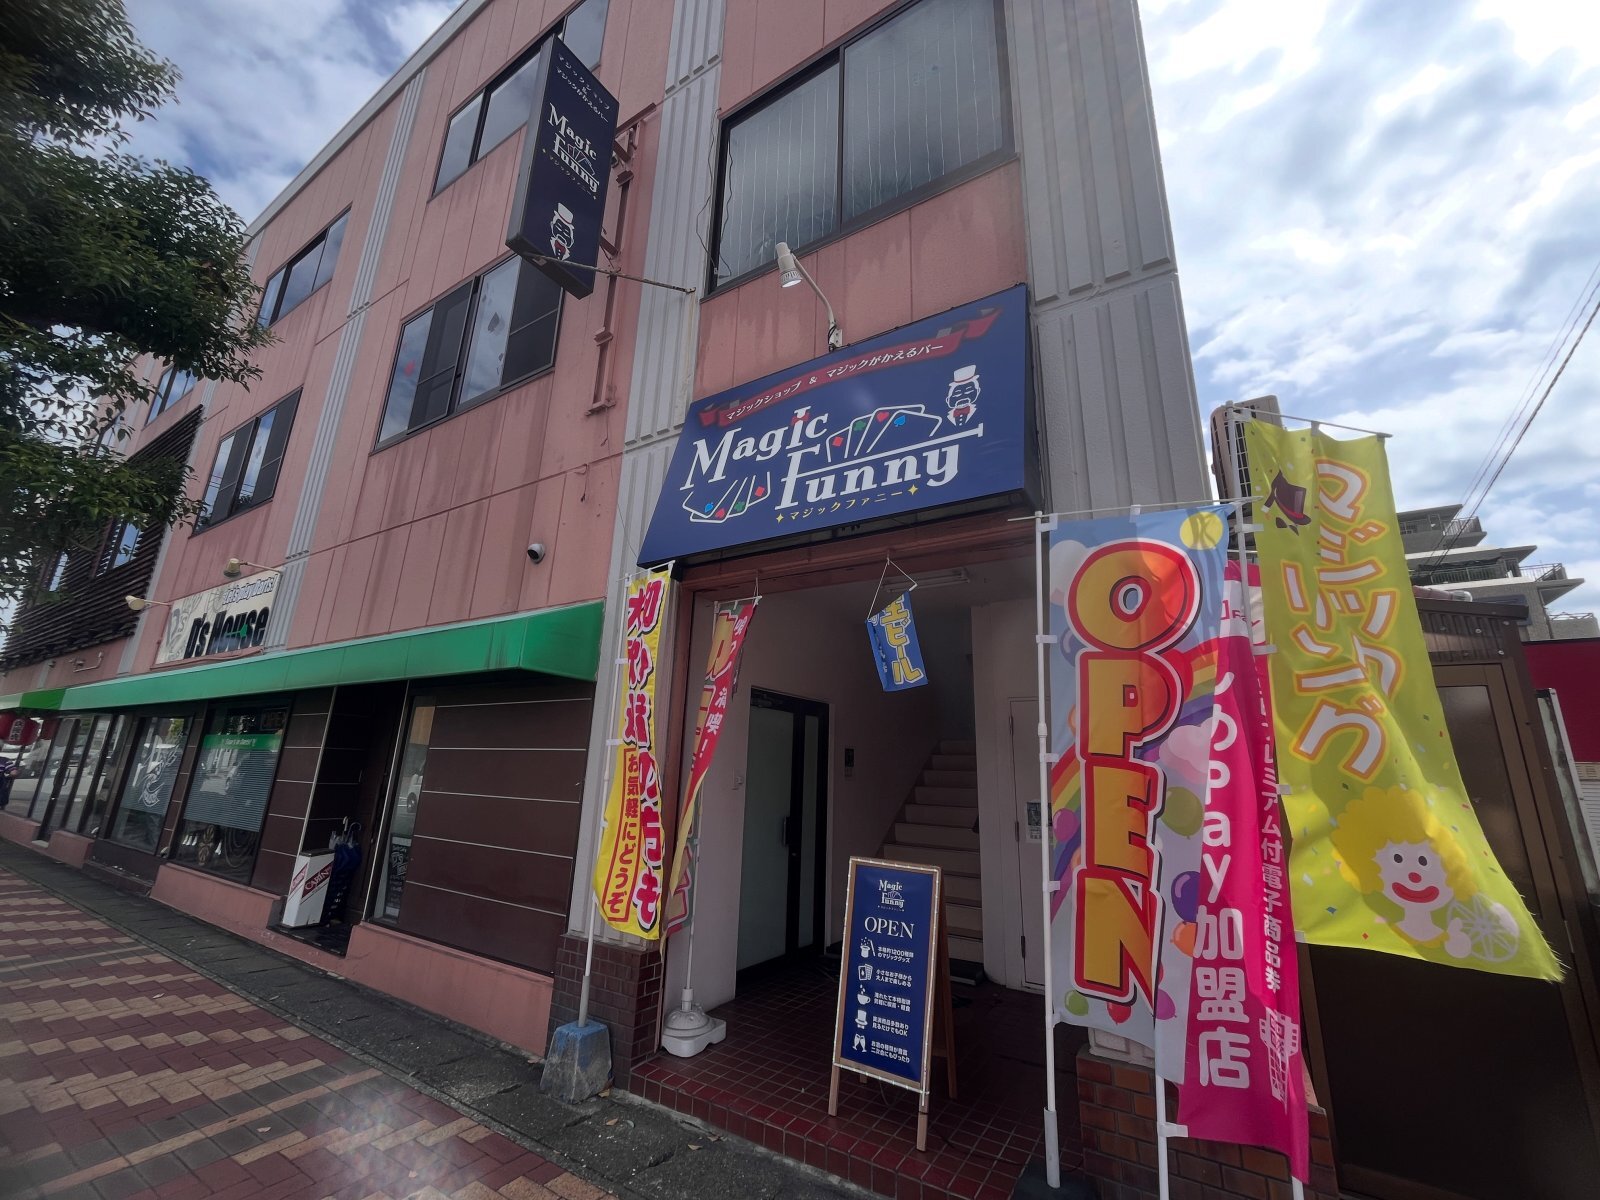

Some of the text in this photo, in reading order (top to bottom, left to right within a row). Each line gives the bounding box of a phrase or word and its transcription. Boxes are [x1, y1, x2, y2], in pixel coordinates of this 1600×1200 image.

[547, 102, 597, 161] Magic
[552, 132, 600, 193] Funny
[726, 344, 944, 421] マジックショップ & マジックがかえるバー
[680, 405, 829, 491] Magic
[774, 436, 968, 511] Funny
[789, 489, 903, 521] マジックファニー
[206, 606, 270, 656] House
[1066, 540, 1201, 1014] OPEN
[607, 753, 639, 914] お気軽にどうぞ
[879, 879, 903, 892] Magic
[881, 892, 905, 908] Funny
[864, 916, 915, 939] OPEN
